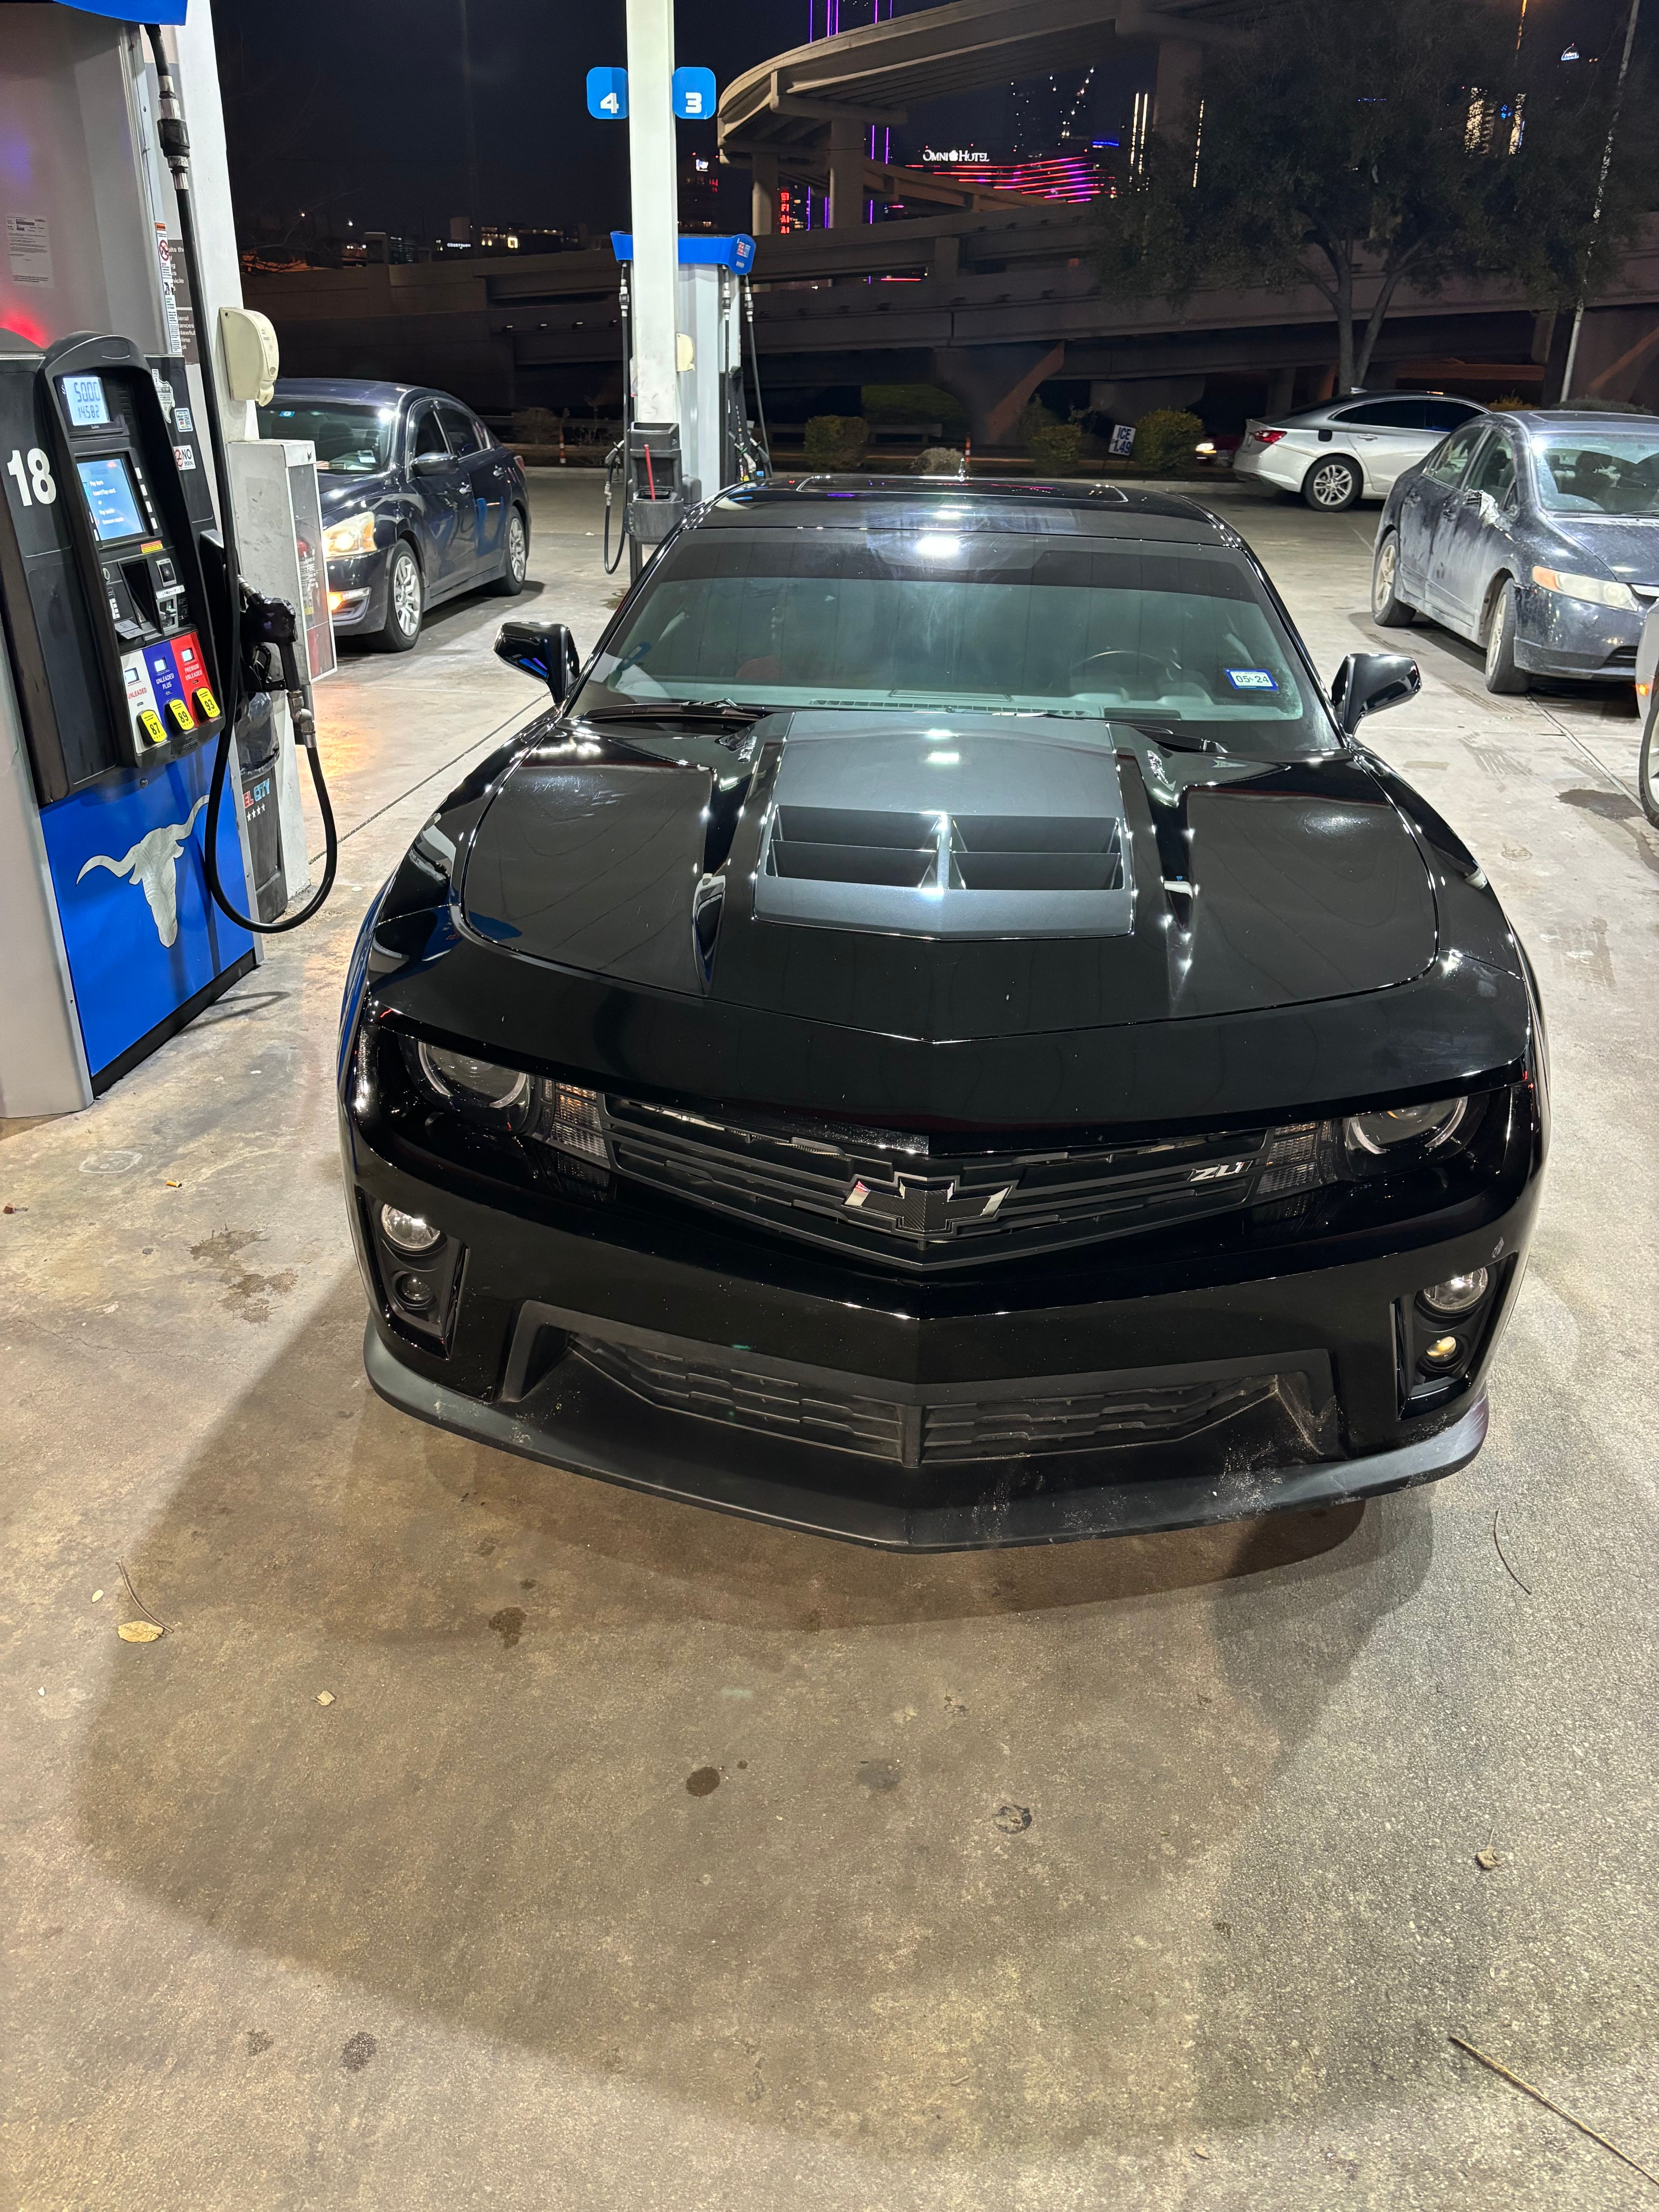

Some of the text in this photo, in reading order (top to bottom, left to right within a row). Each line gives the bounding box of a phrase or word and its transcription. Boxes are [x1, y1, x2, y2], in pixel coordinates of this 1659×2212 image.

[600, 93, 619, 113] 4
[685, 92, 702, 113] 3
[923, 149, 990, 161] OMNI HOTEL
[1117, 427, 1132, 440] ICE
[182, 449, 191, 460] NO
[7, 448, 56, 506] 18
[156, 673, 174, 684] UNLEADED
[185, 670, 202, 681] UNLEADED
[128, 687, 147, 699] UNLEADED
[204, 699, 215, 711] 93
[178, 711, 189, 723] 89
[150, 722, 160, 735] 87
[254, 778, 270, 802] CITY
[1190, 1161, 1246, 1182] ZL1
